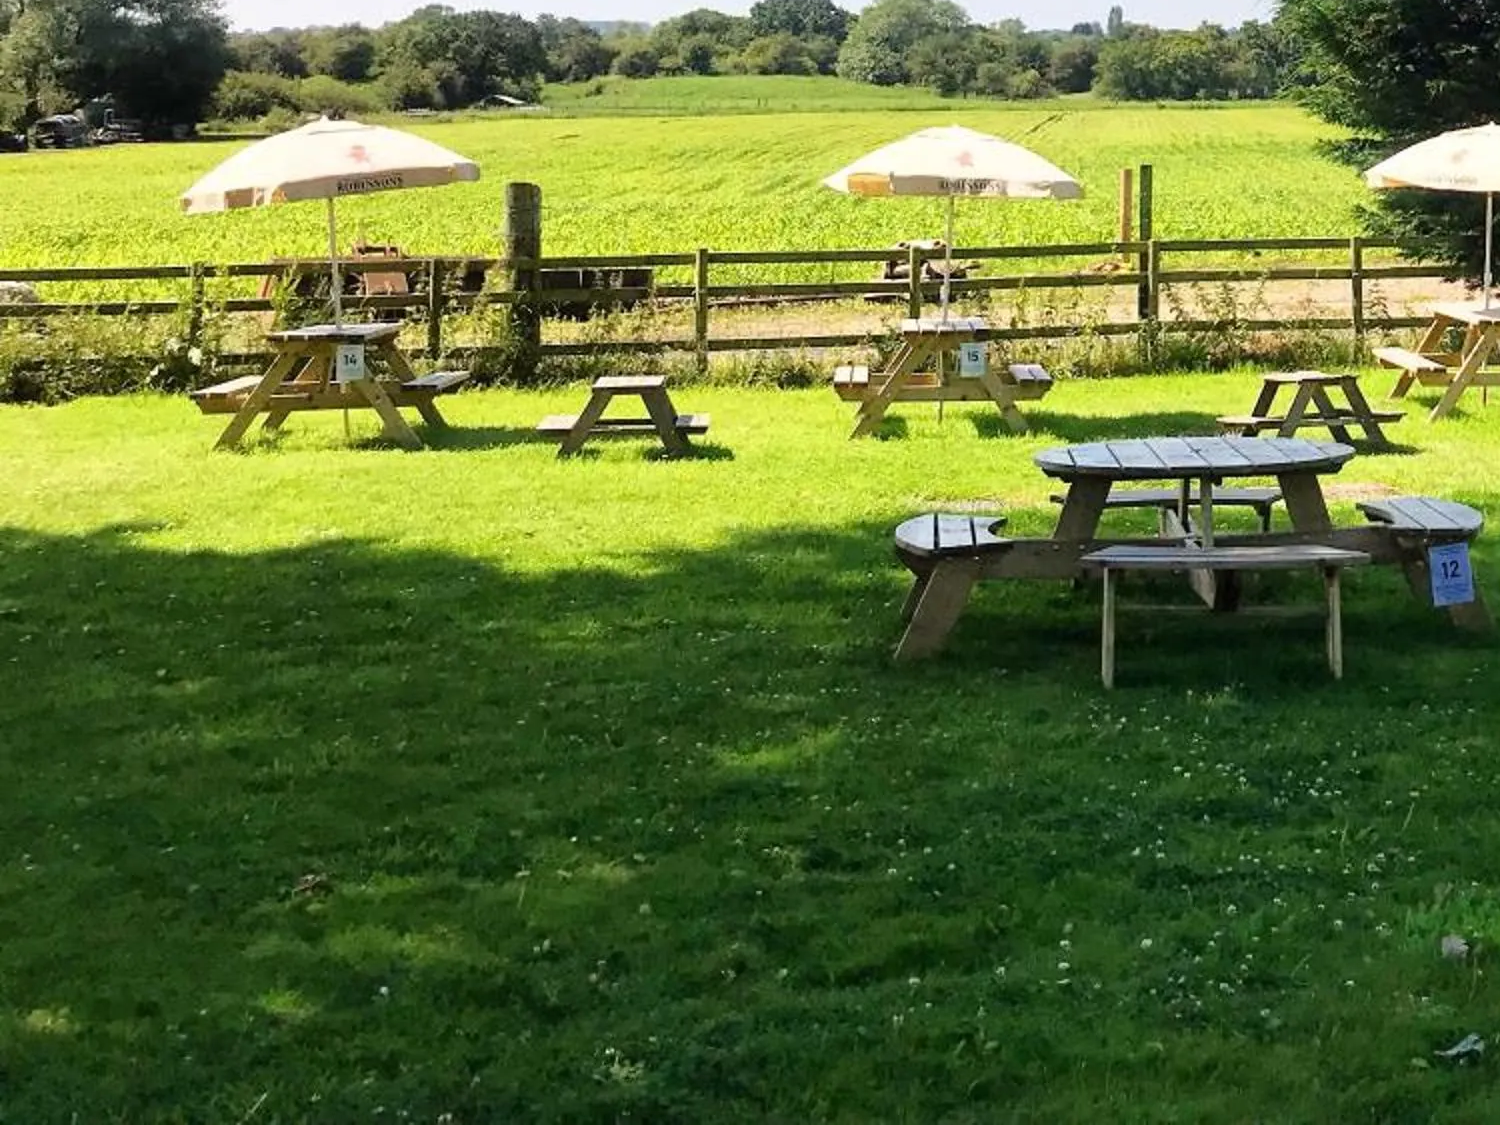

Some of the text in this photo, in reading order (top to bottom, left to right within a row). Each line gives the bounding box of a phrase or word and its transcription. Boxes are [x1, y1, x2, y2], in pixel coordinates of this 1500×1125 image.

[343, 354, 357, 367] 14
[967, 350, 979, 362] 15
[1441, 559, 1461, 580] 12
